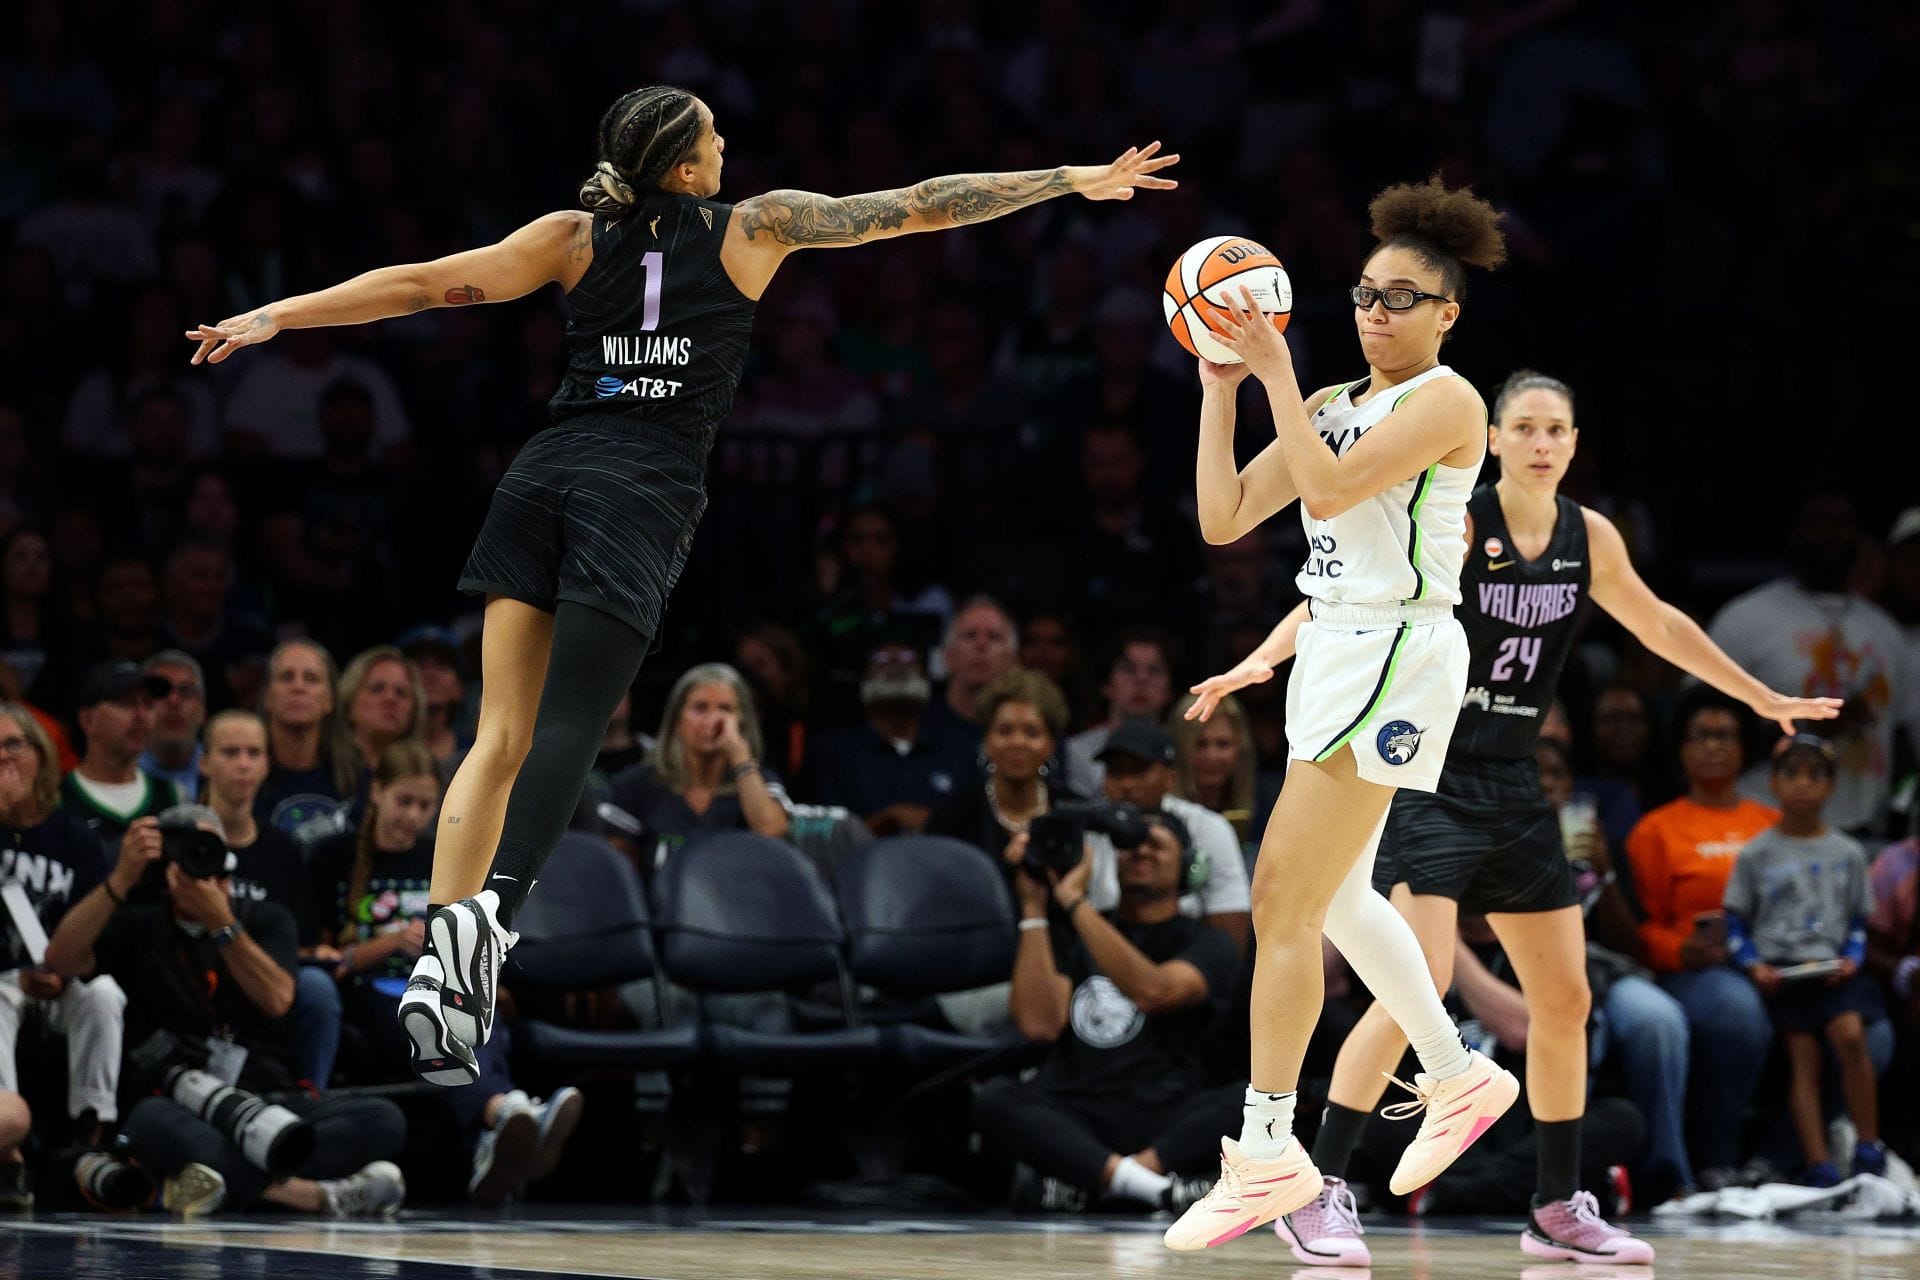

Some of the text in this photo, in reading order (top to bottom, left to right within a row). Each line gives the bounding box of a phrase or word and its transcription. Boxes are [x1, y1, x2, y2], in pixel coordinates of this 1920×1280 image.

[1218, 242, 1271, 265] Wil
[640, 252, 663, 331] 1
[602, 335, 692, 366] WILLIAMS
[621, 376, 683, 398] AT&T
[1478, 582, 1579, 629] VALKYRIES
[1490, 636, 1542, 682] 24
